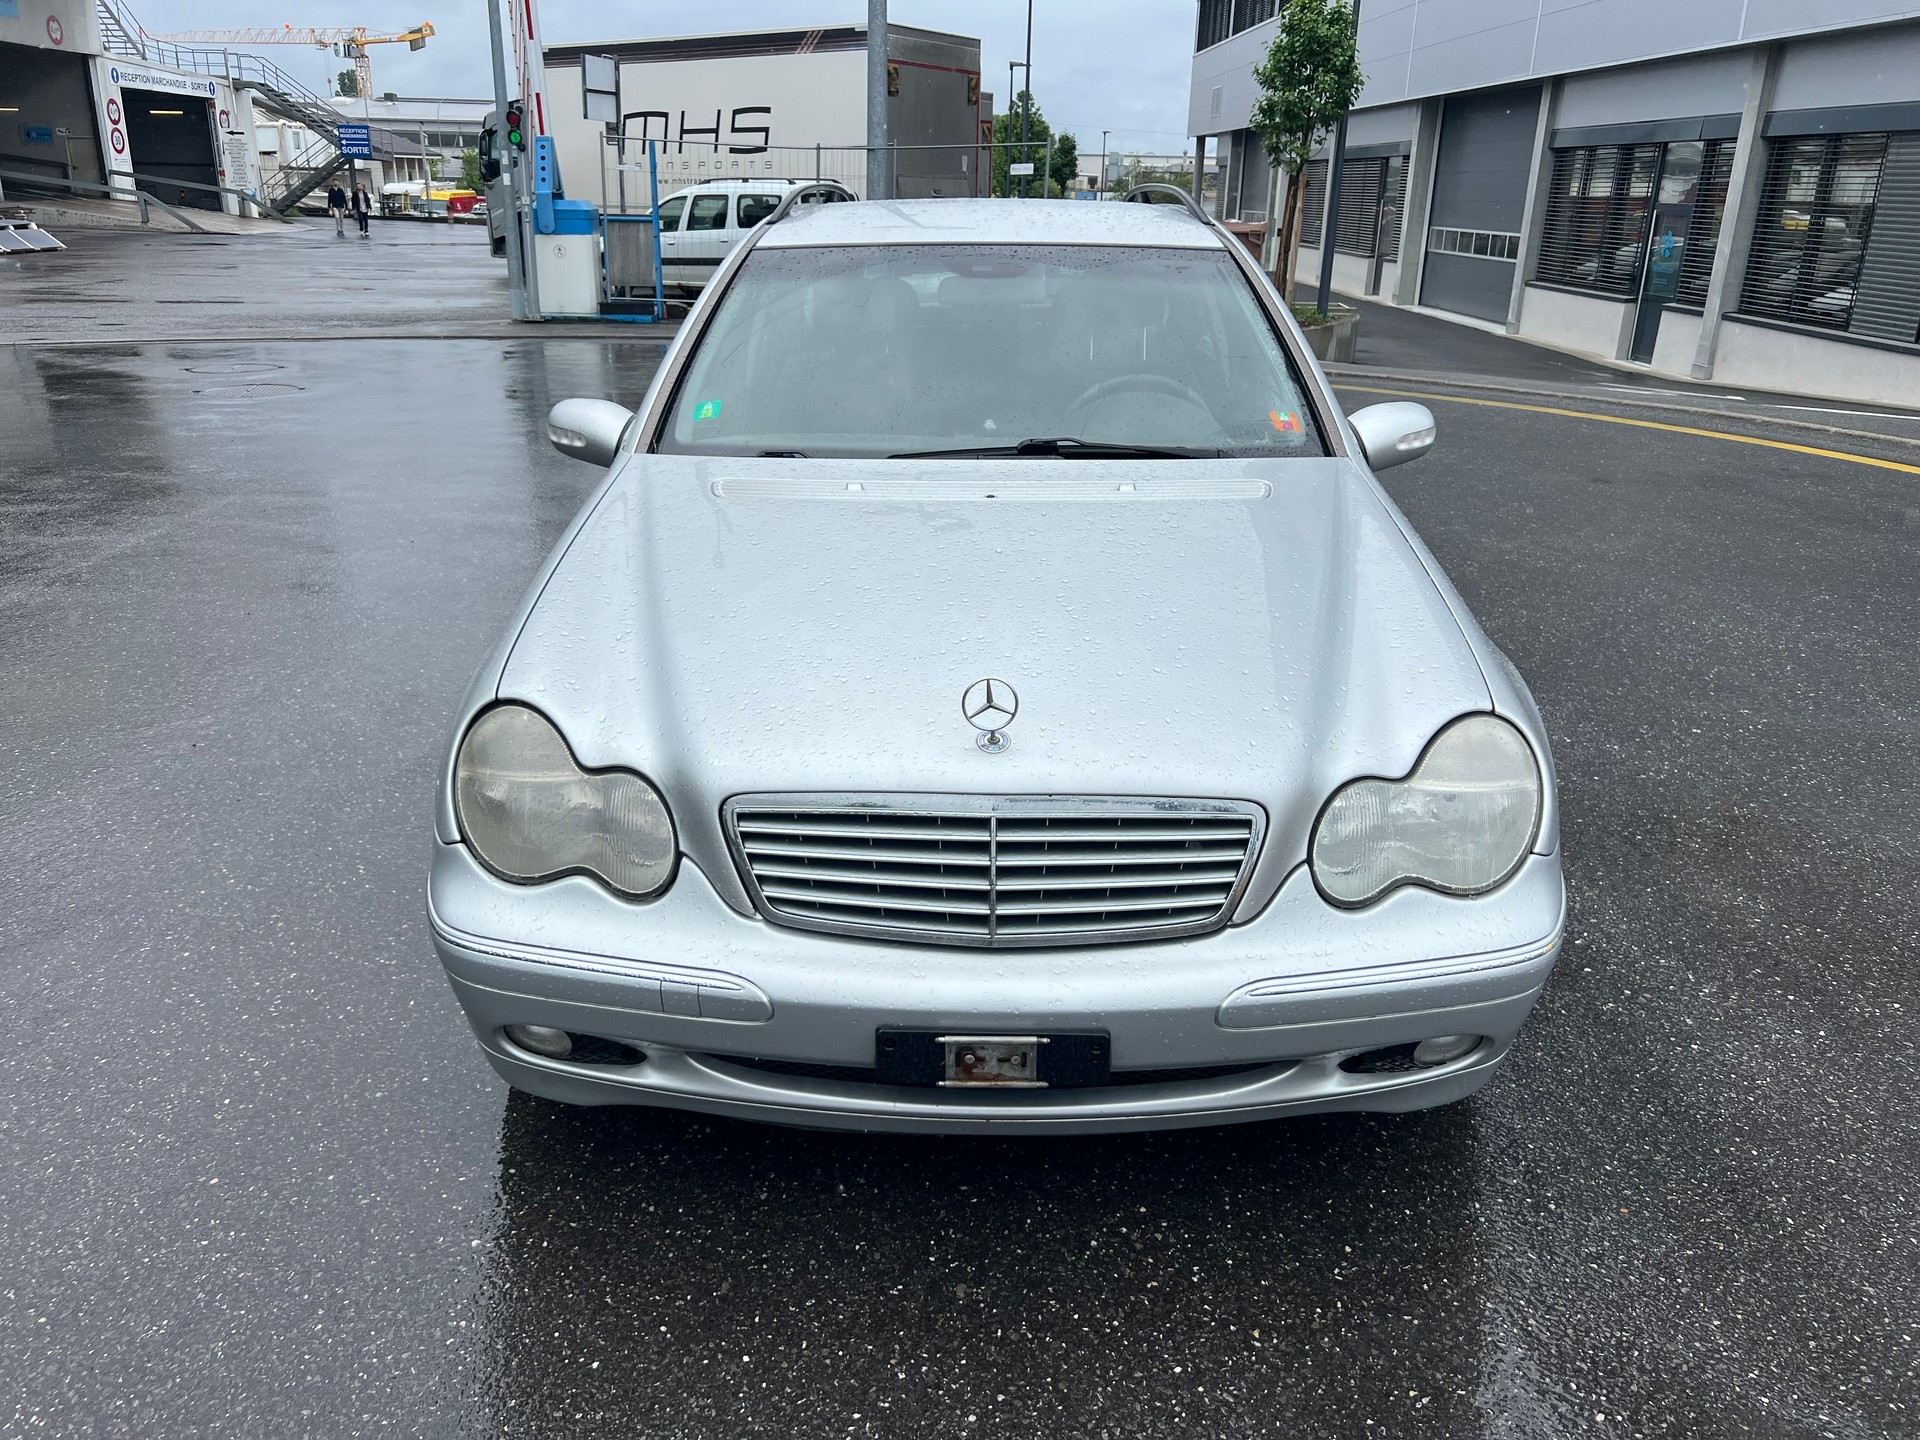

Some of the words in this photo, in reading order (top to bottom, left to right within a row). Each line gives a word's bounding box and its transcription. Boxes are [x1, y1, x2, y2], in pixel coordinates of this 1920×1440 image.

[120, 72, 151, 84] RECEPTION
[151, 76, 187, 89] MARCHANDISE
[191, 83, 208, 92] SORTIE
[622, 107, 771, 154] MHS
